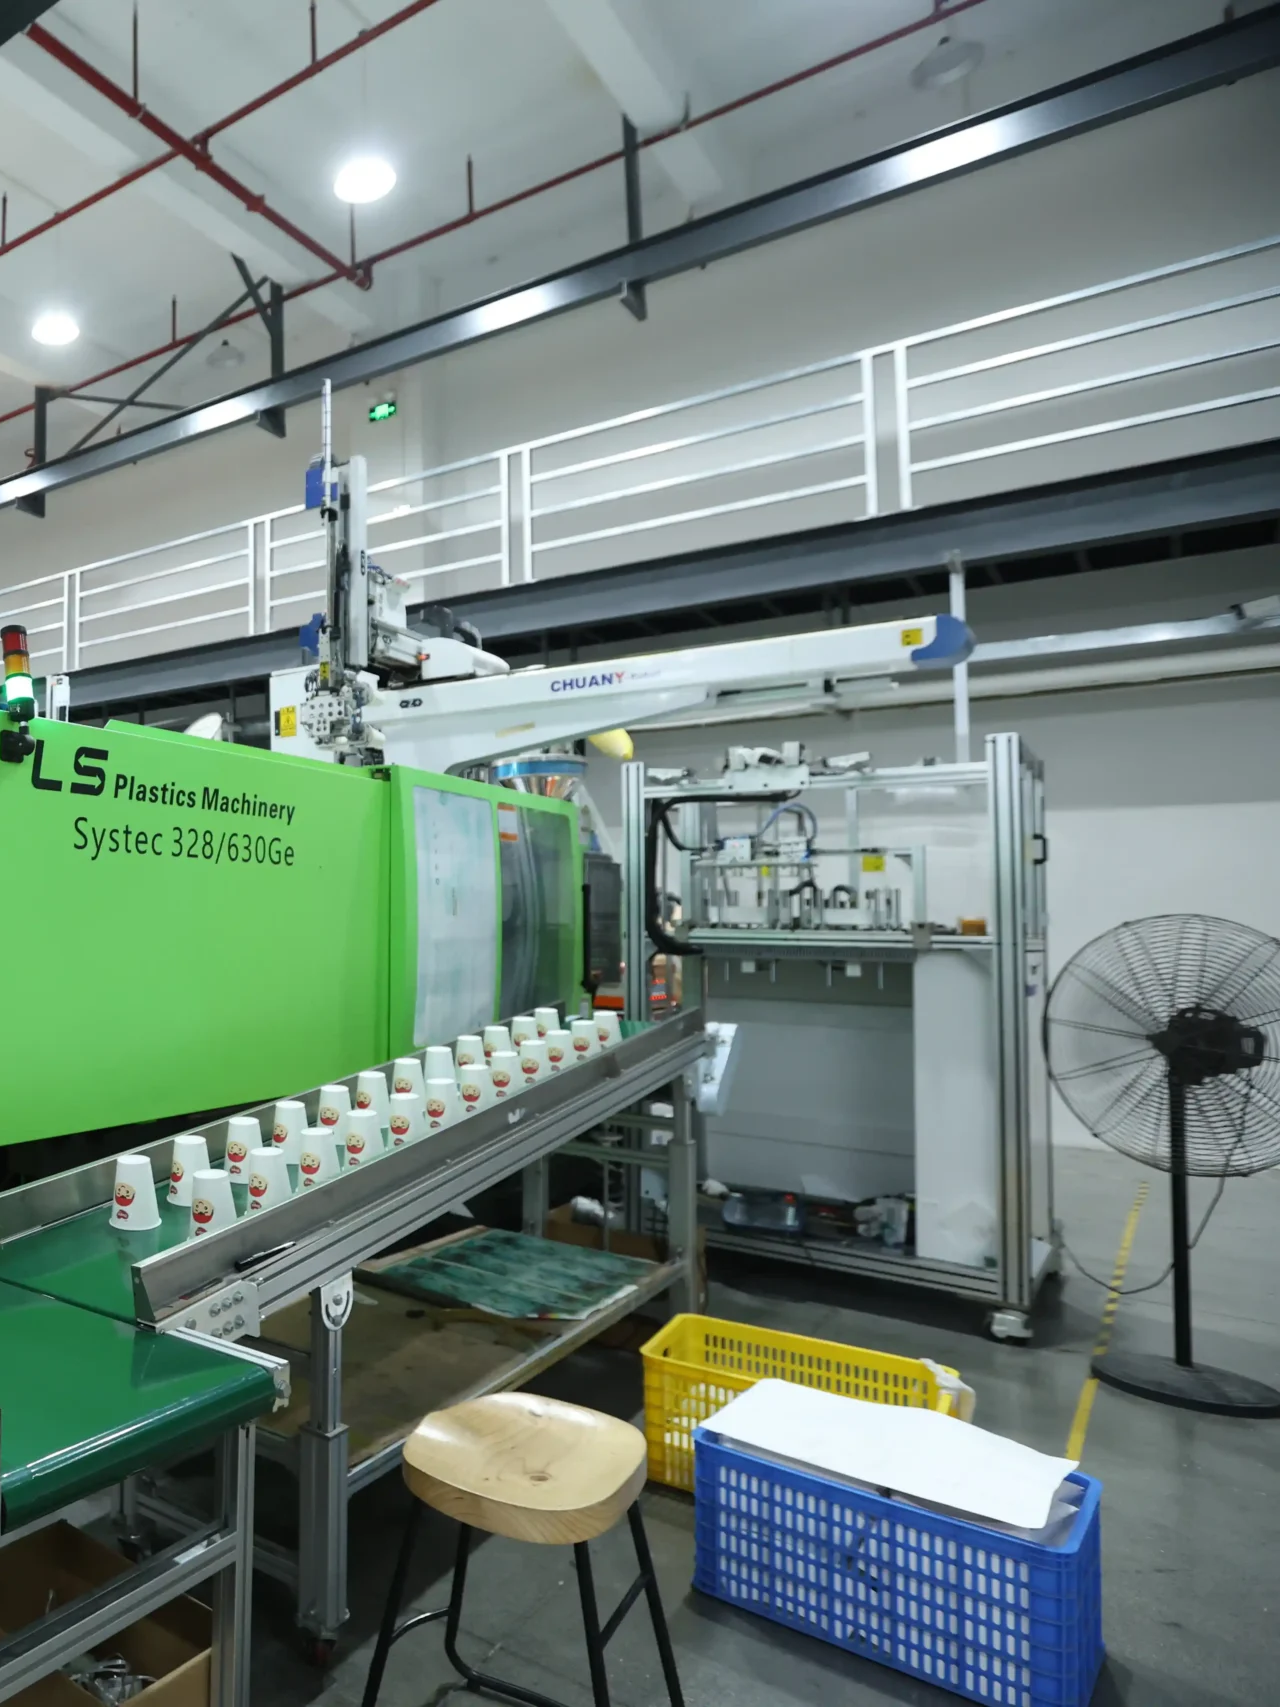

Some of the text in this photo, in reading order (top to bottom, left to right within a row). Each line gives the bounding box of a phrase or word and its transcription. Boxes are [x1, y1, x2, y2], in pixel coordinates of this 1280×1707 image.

[550, 671, 625, 692] CHUANY
[31, 739, 295, 825] LS Plastics Machinery
[73, 817, 295, 866] Systec 328/630Ge
